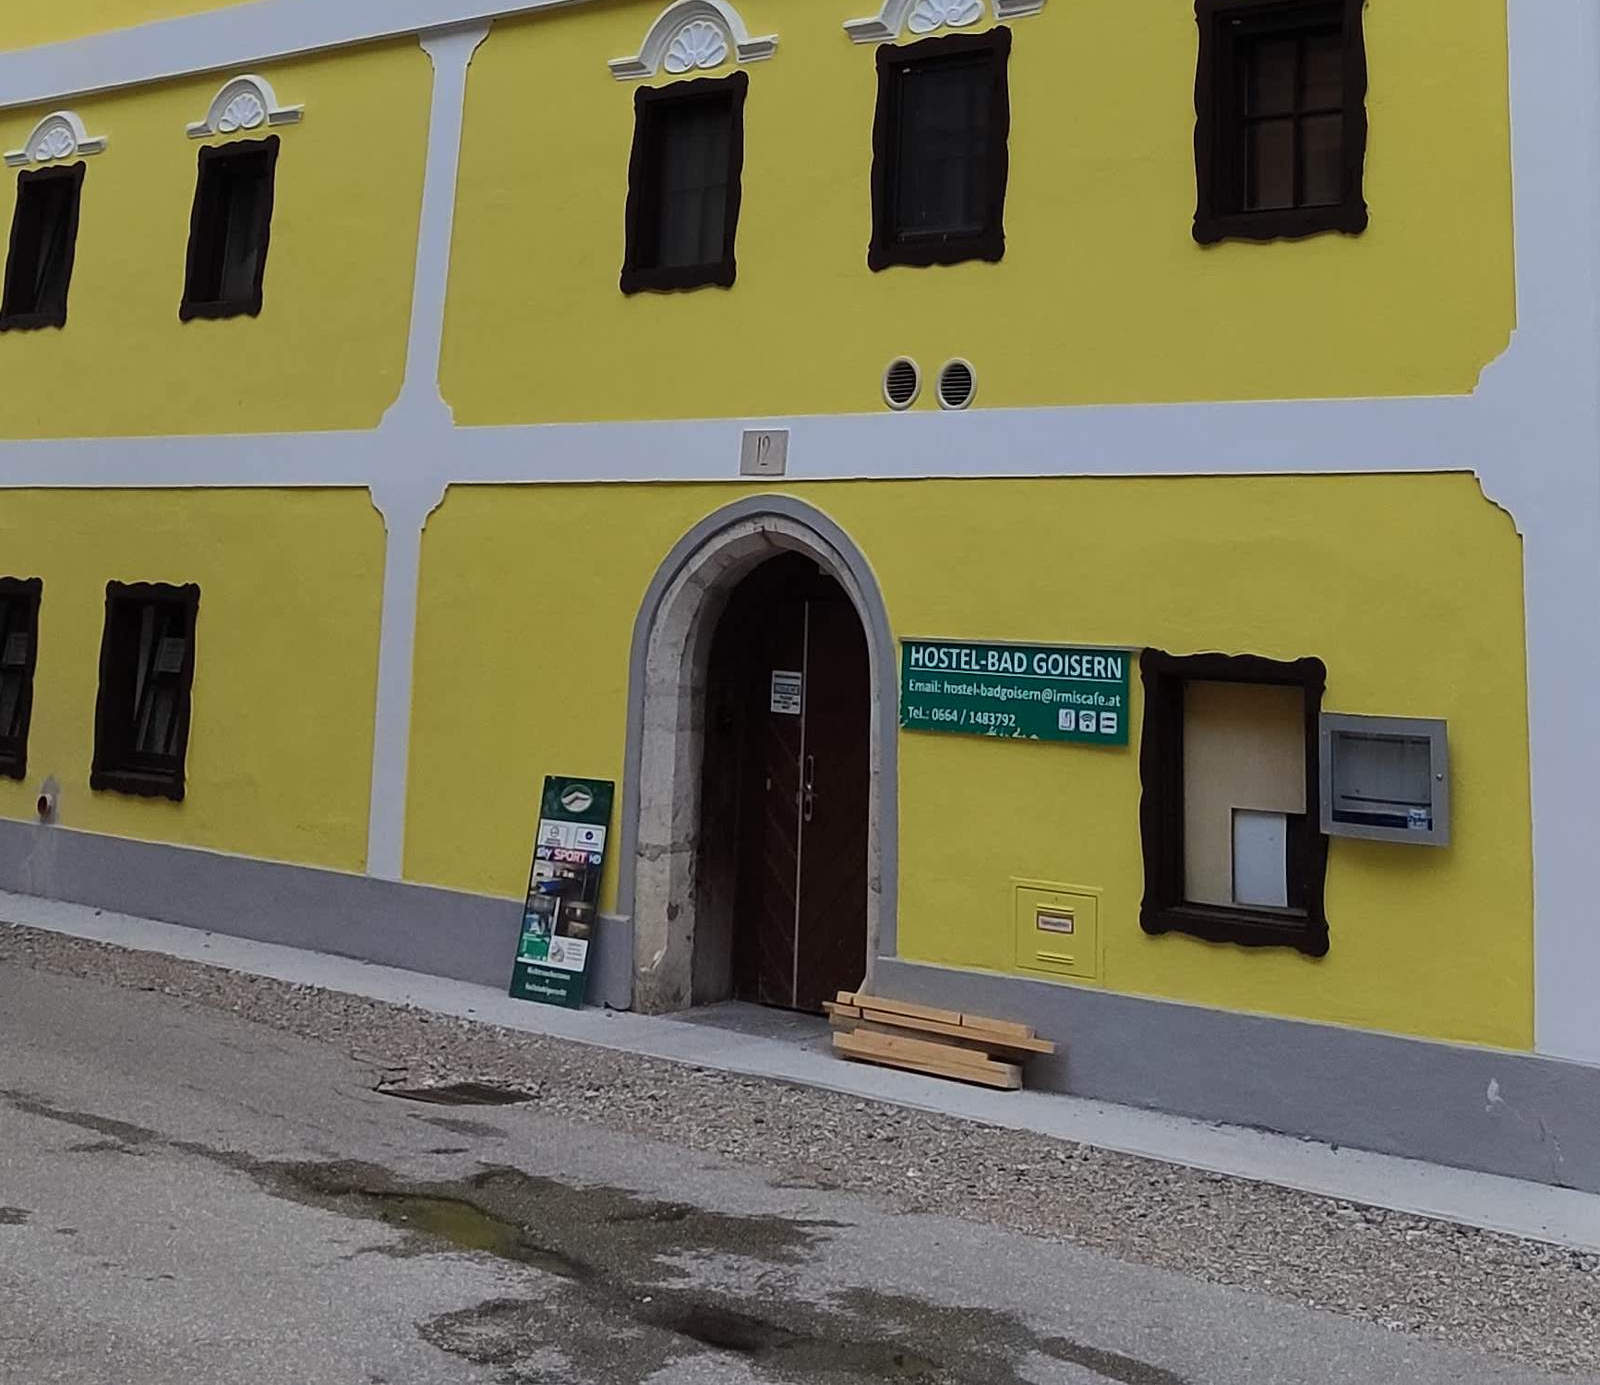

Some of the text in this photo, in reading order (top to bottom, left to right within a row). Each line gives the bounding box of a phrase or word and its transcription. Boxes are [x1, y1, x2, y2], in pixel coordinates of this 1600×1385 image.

[757, 435, 770, 466] 12
[911, 646, 1122, 679] HOSTEL-BAD GOISERN
[909, 679, 1121, 707] Email: hostel-badgoisern@irmiscafe.at
[931, 708, 958, 722] 0664
[959, 709, 967, 725] /
[969, 711, 1016, 727] 1483792
[553, 848, 587, 864] SPORT
